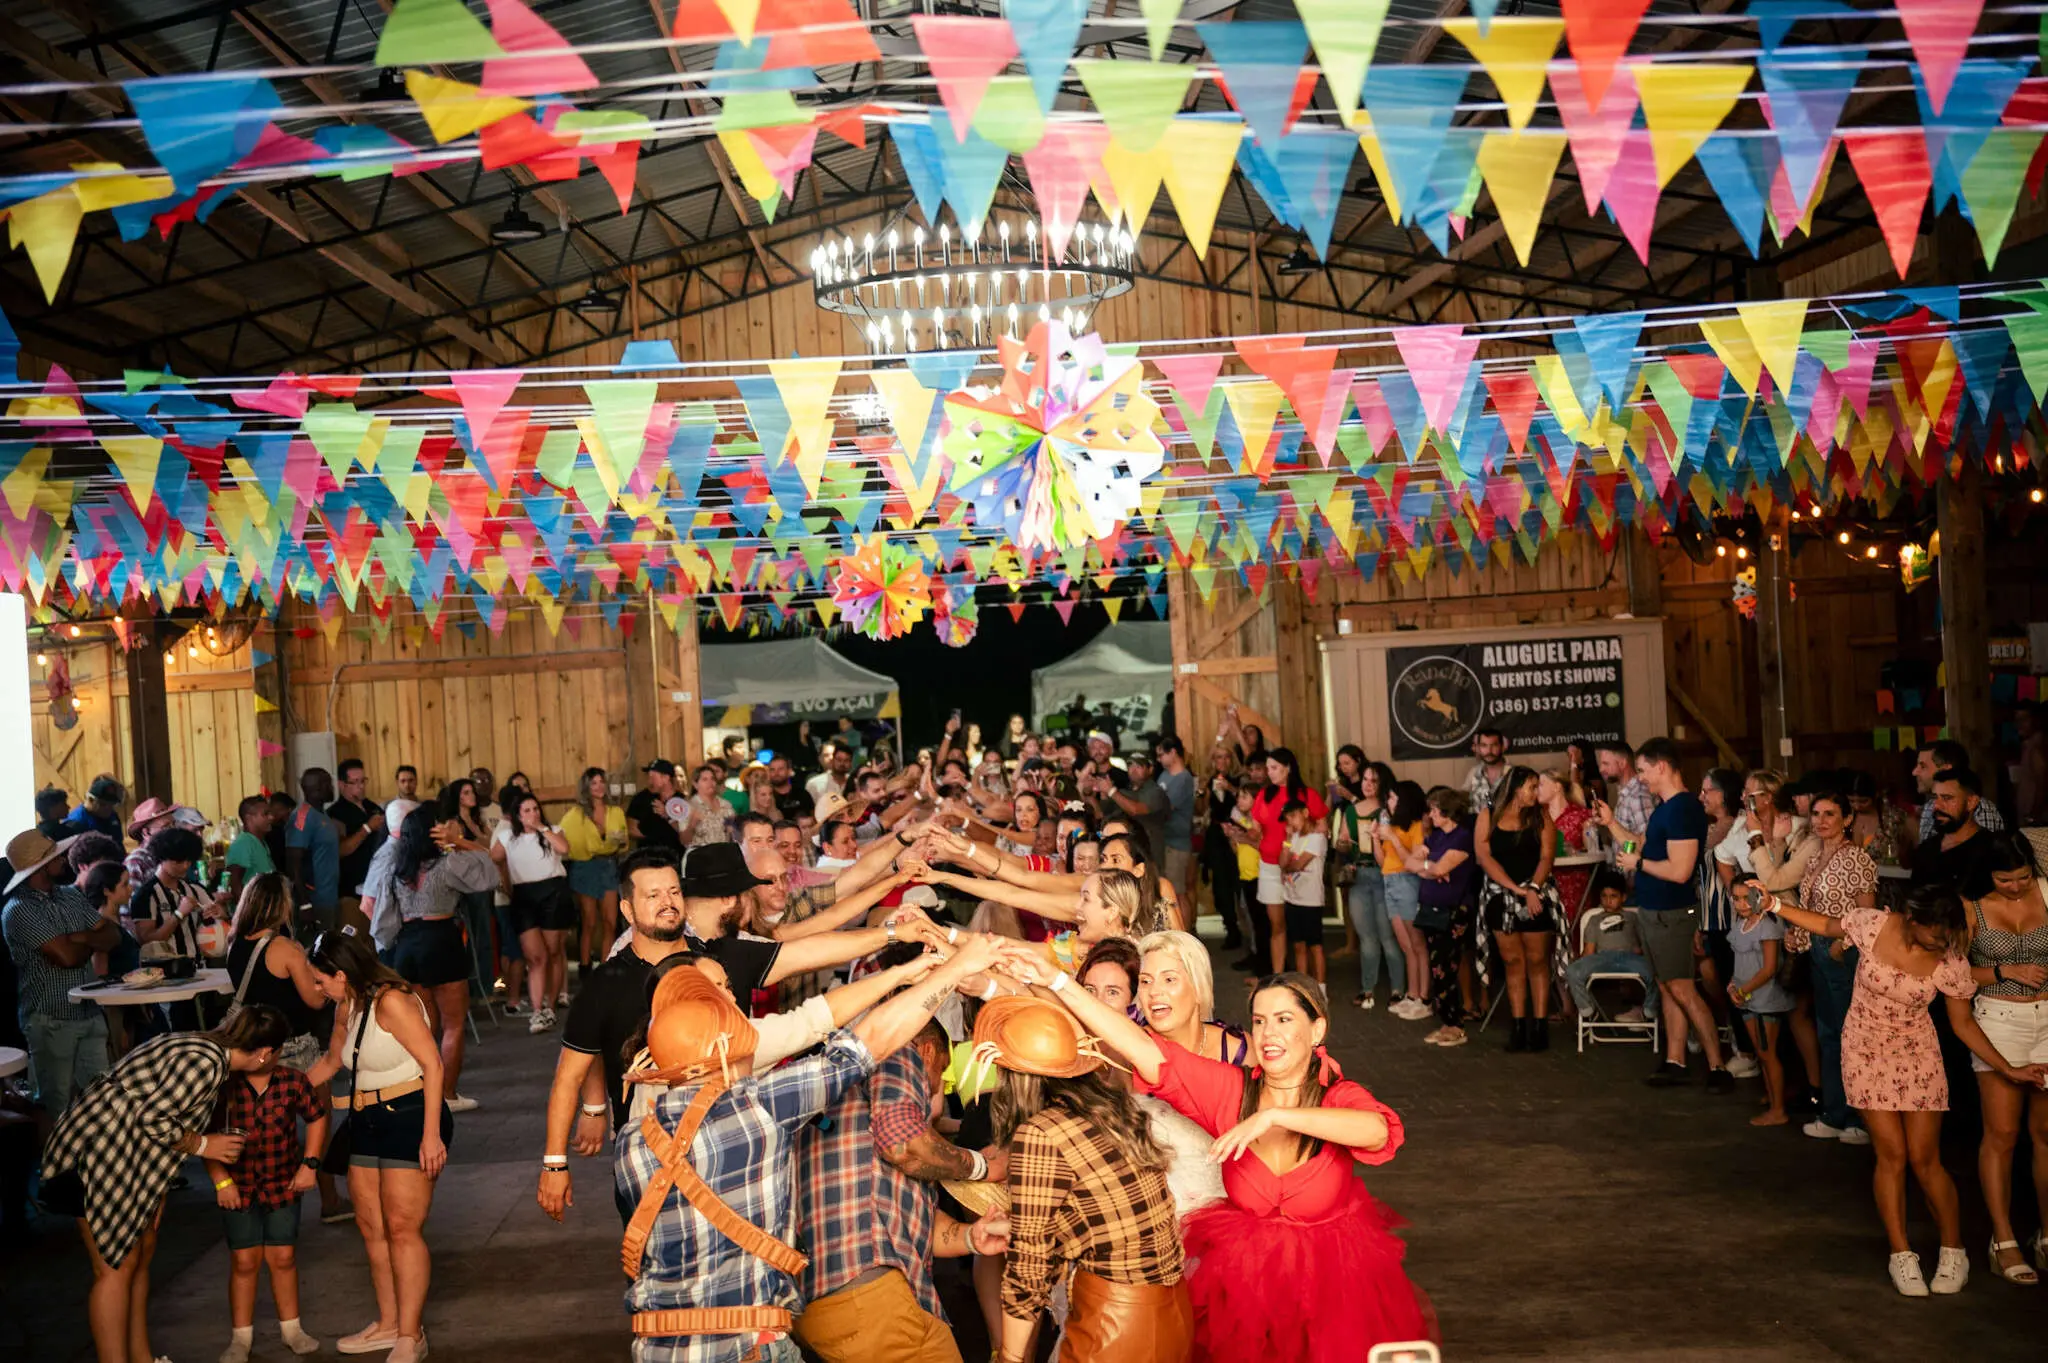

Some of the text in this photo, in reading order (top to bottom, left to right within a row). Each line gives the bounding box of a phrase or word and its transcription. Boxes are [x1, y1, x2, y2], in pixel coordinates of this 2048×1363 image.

[1482, 639, 1622, 667] ALUGUEL PARA
[1491, 667, 1616, 688] EVENTOS E SHOWS
[793, 698, 829, 713] EVO
[1489, 694, 1602, 717] (386) 837-8123
